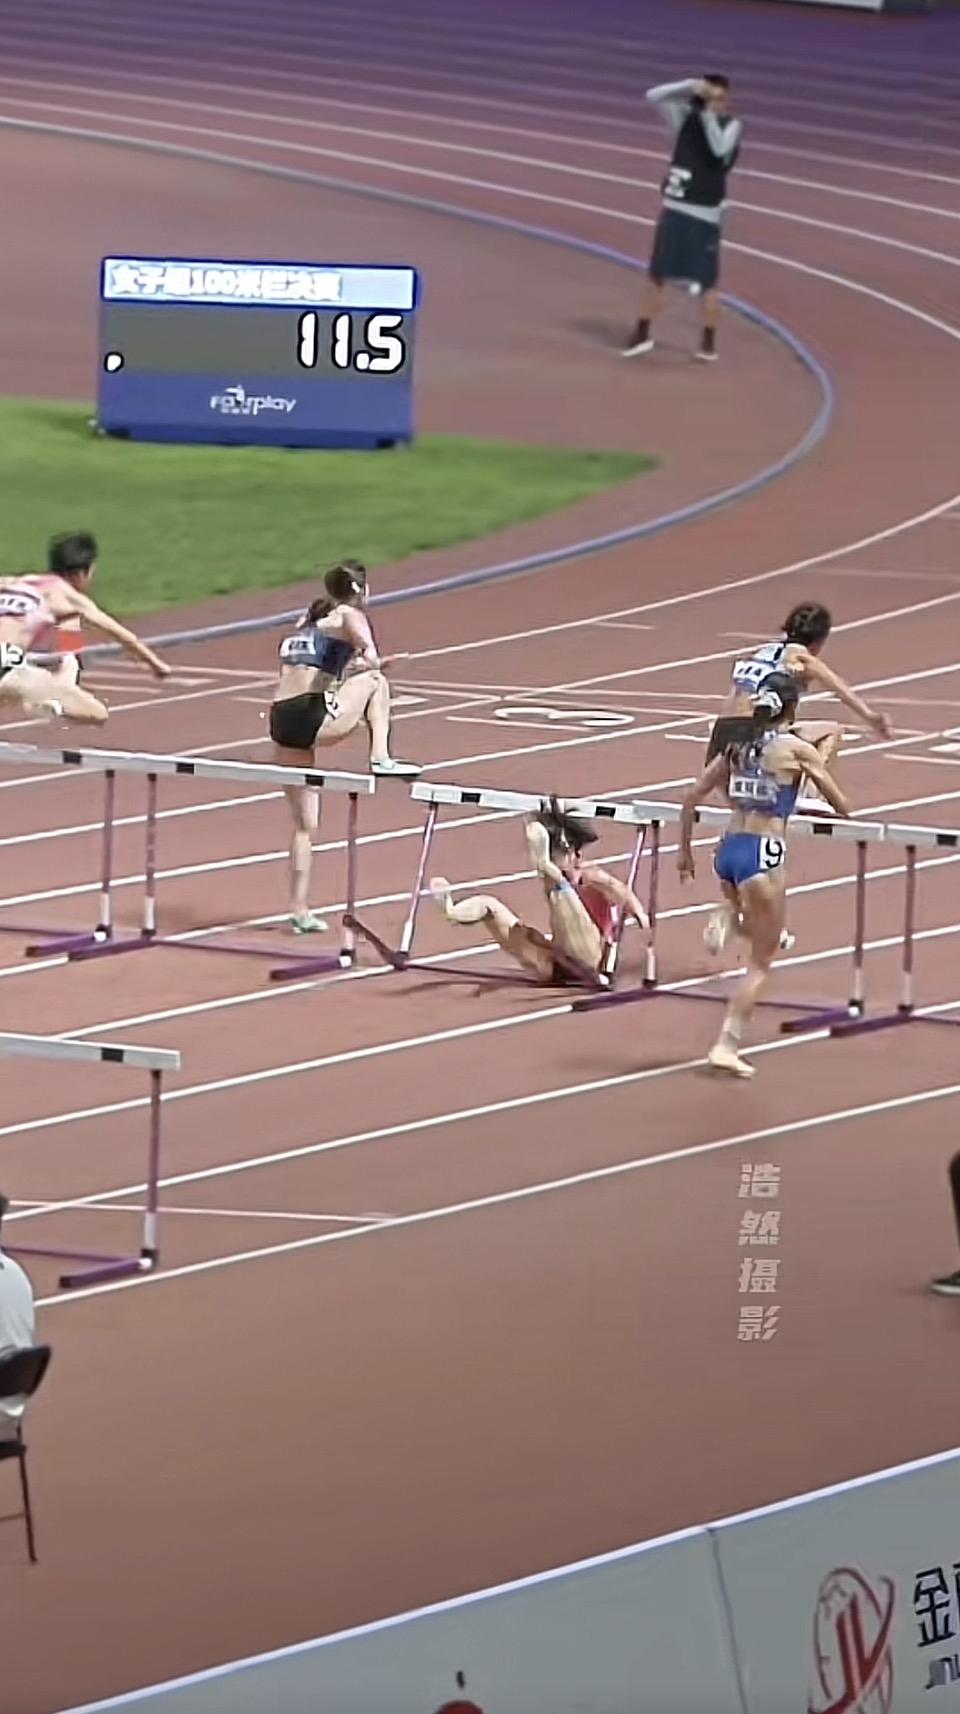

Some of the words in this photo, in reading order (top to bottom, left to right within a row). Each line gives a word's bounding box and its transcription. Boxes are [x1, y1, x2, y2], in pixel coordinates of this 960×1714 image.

[298, 312, 403, 372] 11.5
[765, 838, 783, 869] 9
[914, 1562, 960, 1648] 金
